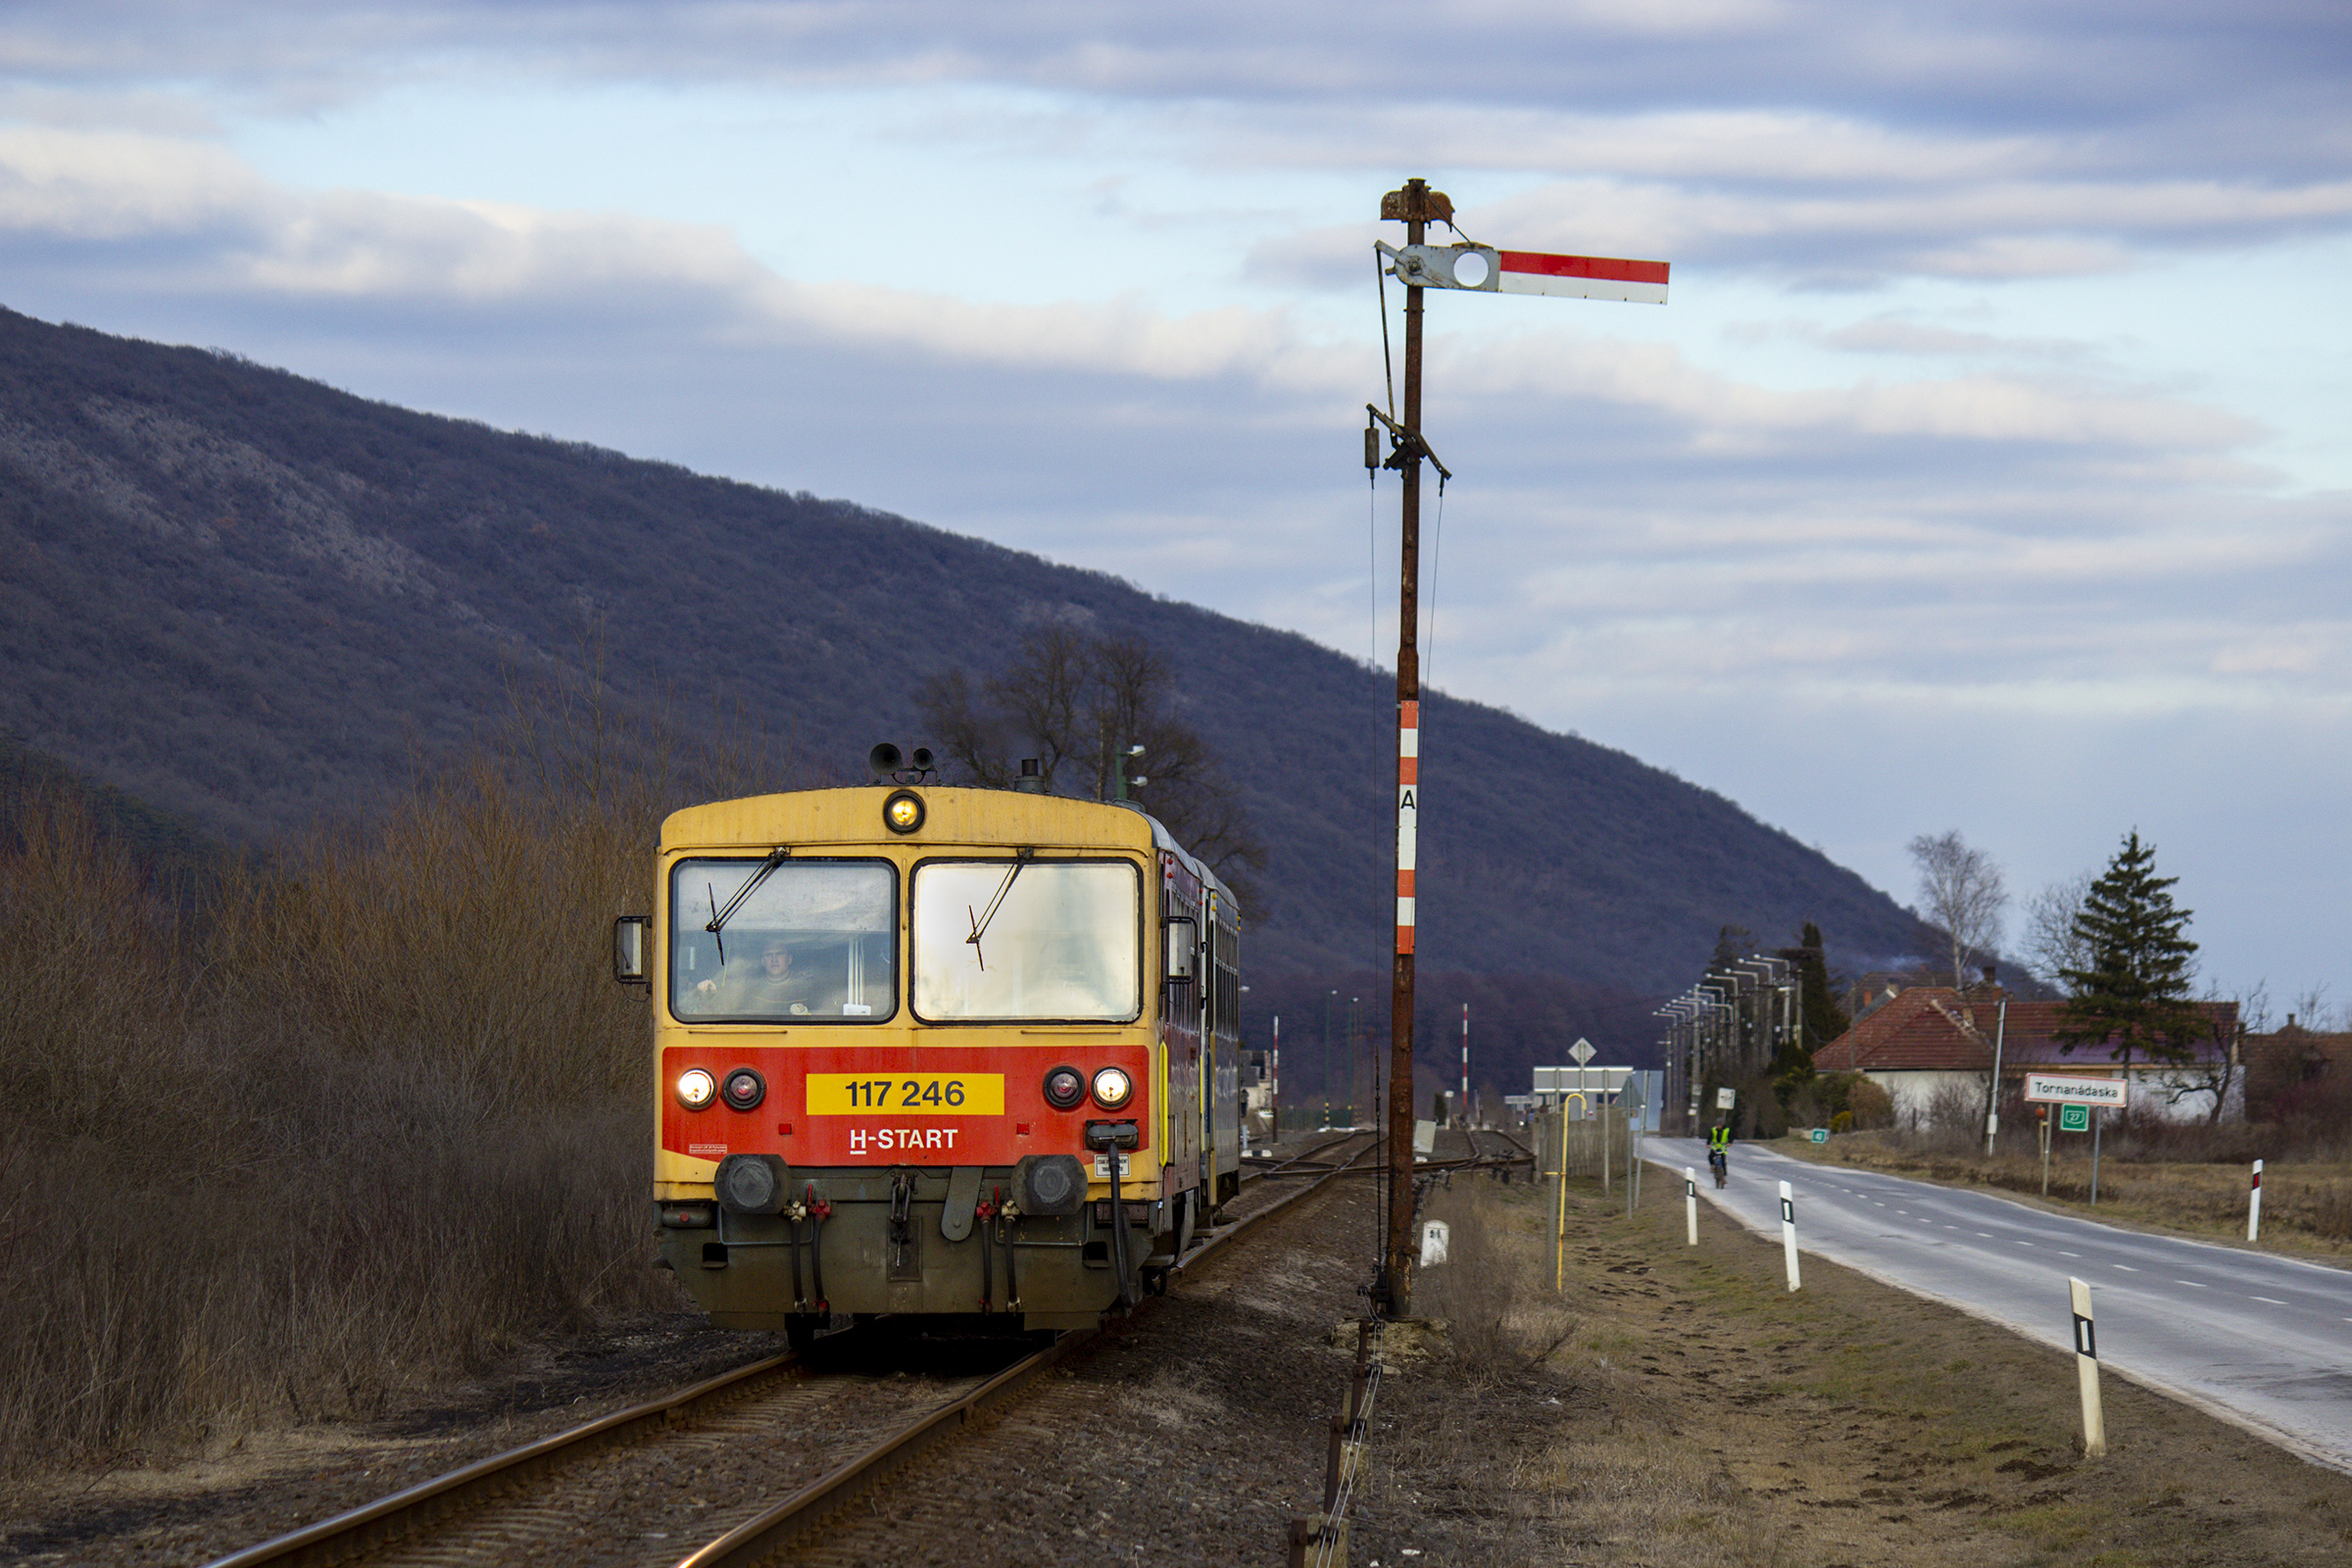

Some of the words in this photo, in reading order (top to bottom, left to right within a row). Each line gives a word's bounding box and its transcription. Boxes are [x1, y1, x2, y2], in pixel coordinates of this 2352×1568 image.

[1400, 790, 1416, 809] A
[845, 1080, 893, 1107] 117
[901, 1080, 965, 1107] 246
[2034, 1081, 2119, 1099] Tornanádaska
[2069, 1112, 2081, 1122] 27
[850, 1128, 958, 1152] H-START
